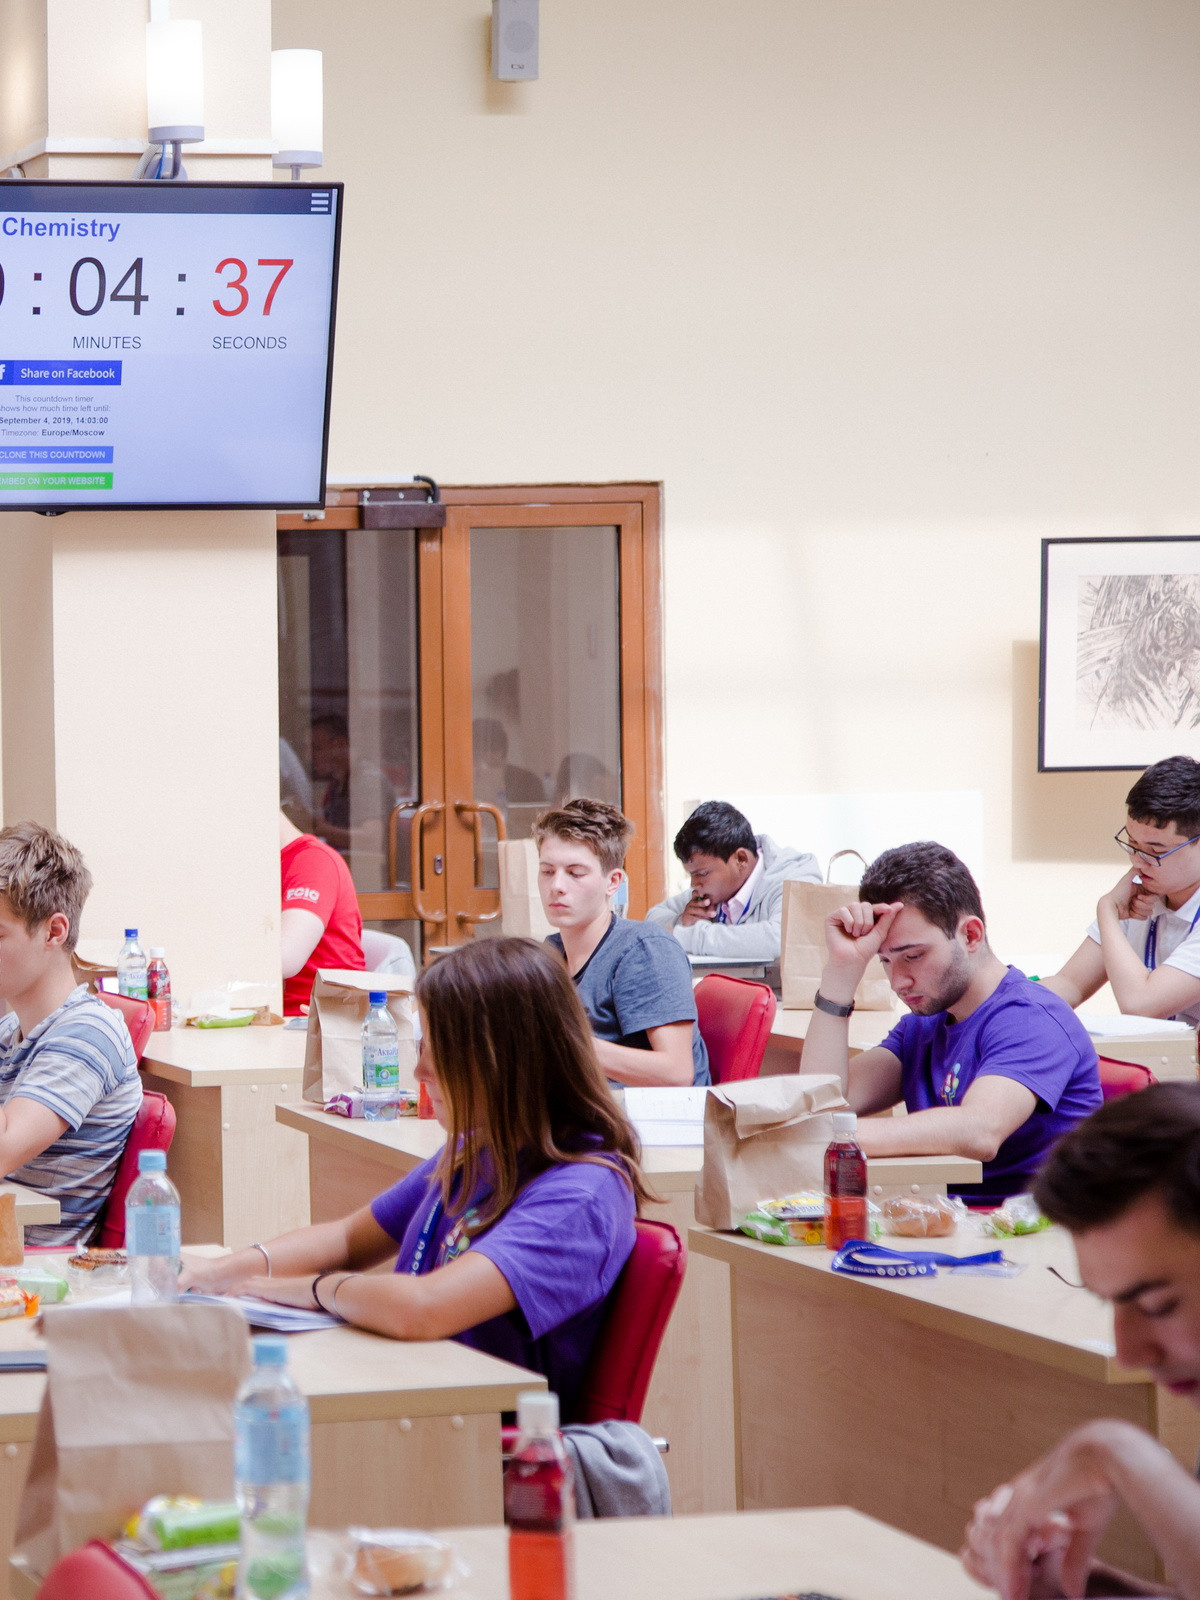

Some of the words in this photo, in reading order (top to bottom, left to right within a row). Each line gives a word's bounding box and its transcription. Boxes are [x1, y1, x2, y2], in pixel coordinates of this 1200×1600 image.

[1, 215, 121, 242] Chemistry
[68, 256, 150, 317] 04
[211, 257, 295, 318] 37
[72, 335, 142, 350] MINUTES
[211, 335, 288, 350] SECONDS
[20, 367, 50, 379] Share
[51, 370, 65, 379] on
[67, 368, 116, 379] Facebook
[15, 394, 31, 403] This
[32, 394, 74, 403] countdown
[75, 395, 94, 403] timer
[22, 404, 38, 412] how
[39, 404, 61, 412] much
[62, 404, 79, 412] time
[80, 404, 92, 412] left
[52, 417, 73, 425] 2019,
[41, 429, 105, 437] Europe/Moscow
[29, 450, 48, 459] THIS
[50, 450, 106, 459] COUNTDOWN
[28, 477, 40, 485] ON
[43, 477, 66, 485] YOUR
[68, 476, 106, 485] WEBSITE
